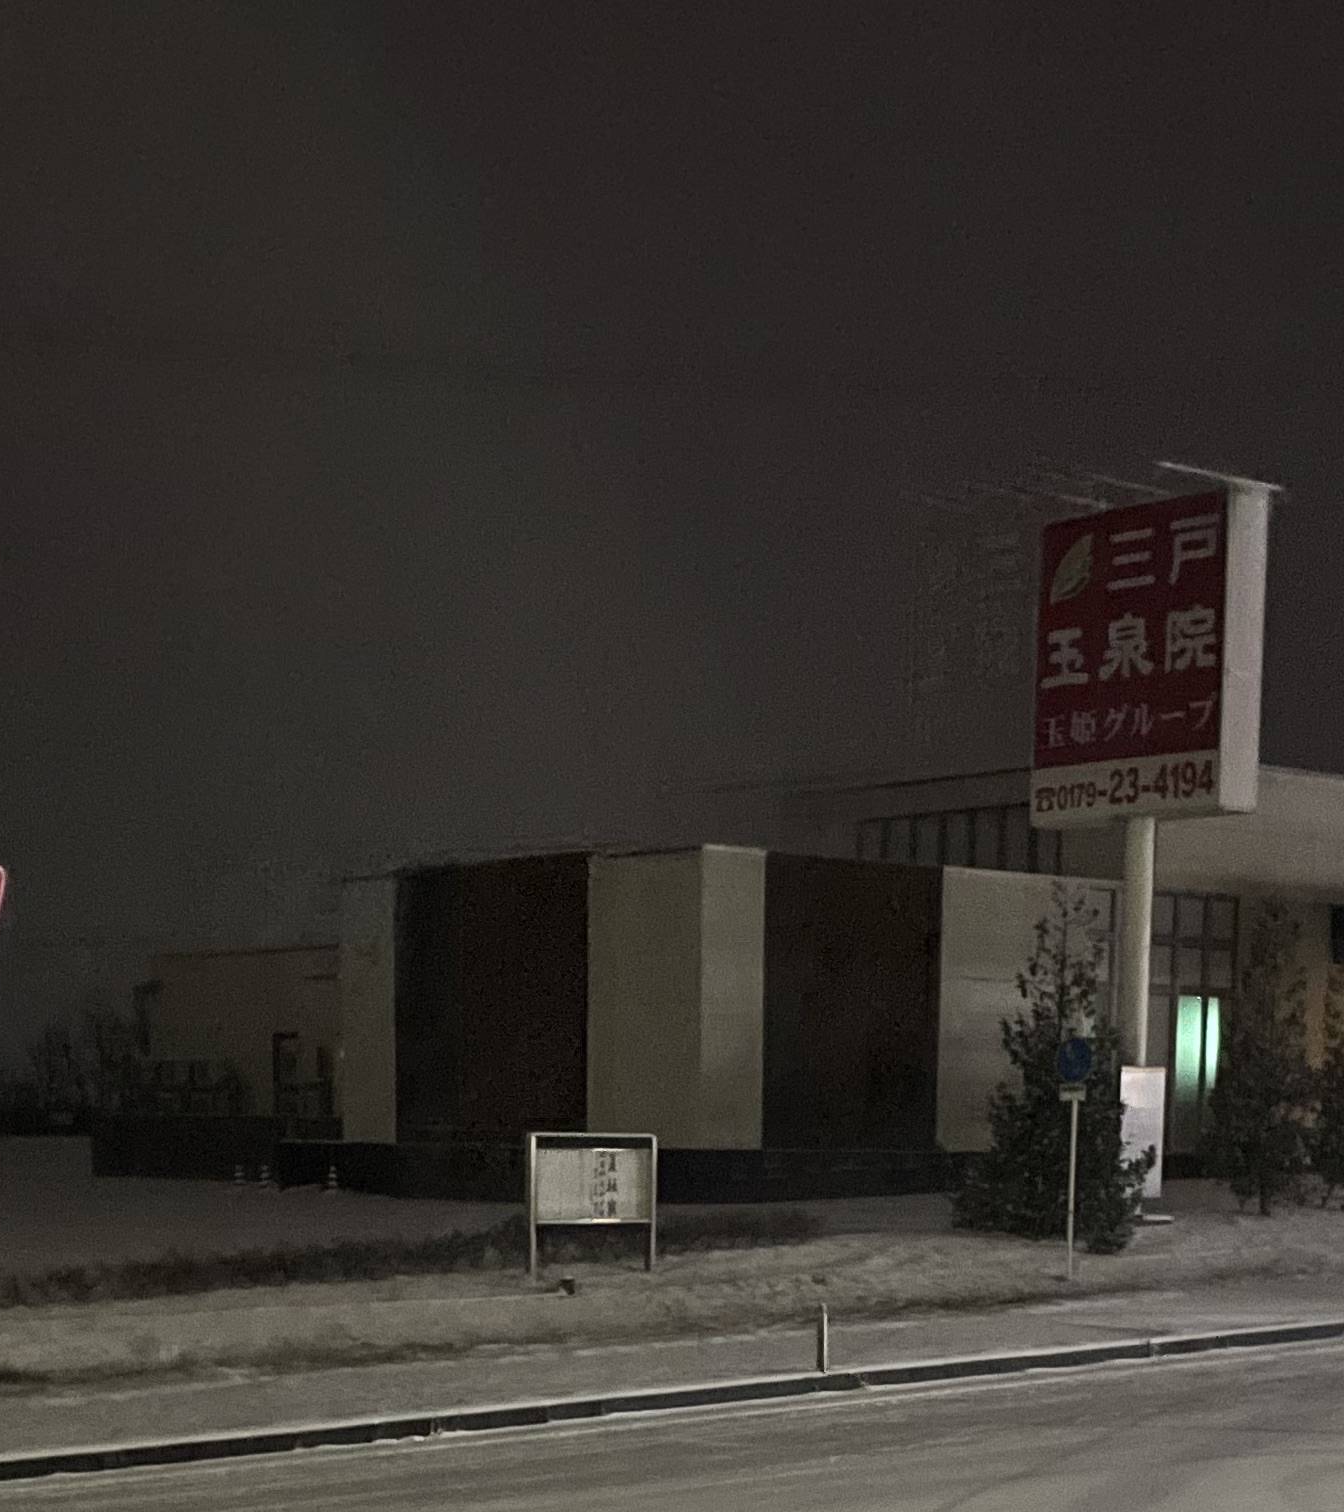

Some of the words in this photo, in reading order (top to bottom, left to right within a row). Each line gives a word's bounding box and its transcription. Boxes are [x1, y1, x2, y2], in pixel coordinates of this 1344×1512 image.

[1108, 513, 1219, 590] 三戸
[1041, 605, 1216, 688] 玉泉院
